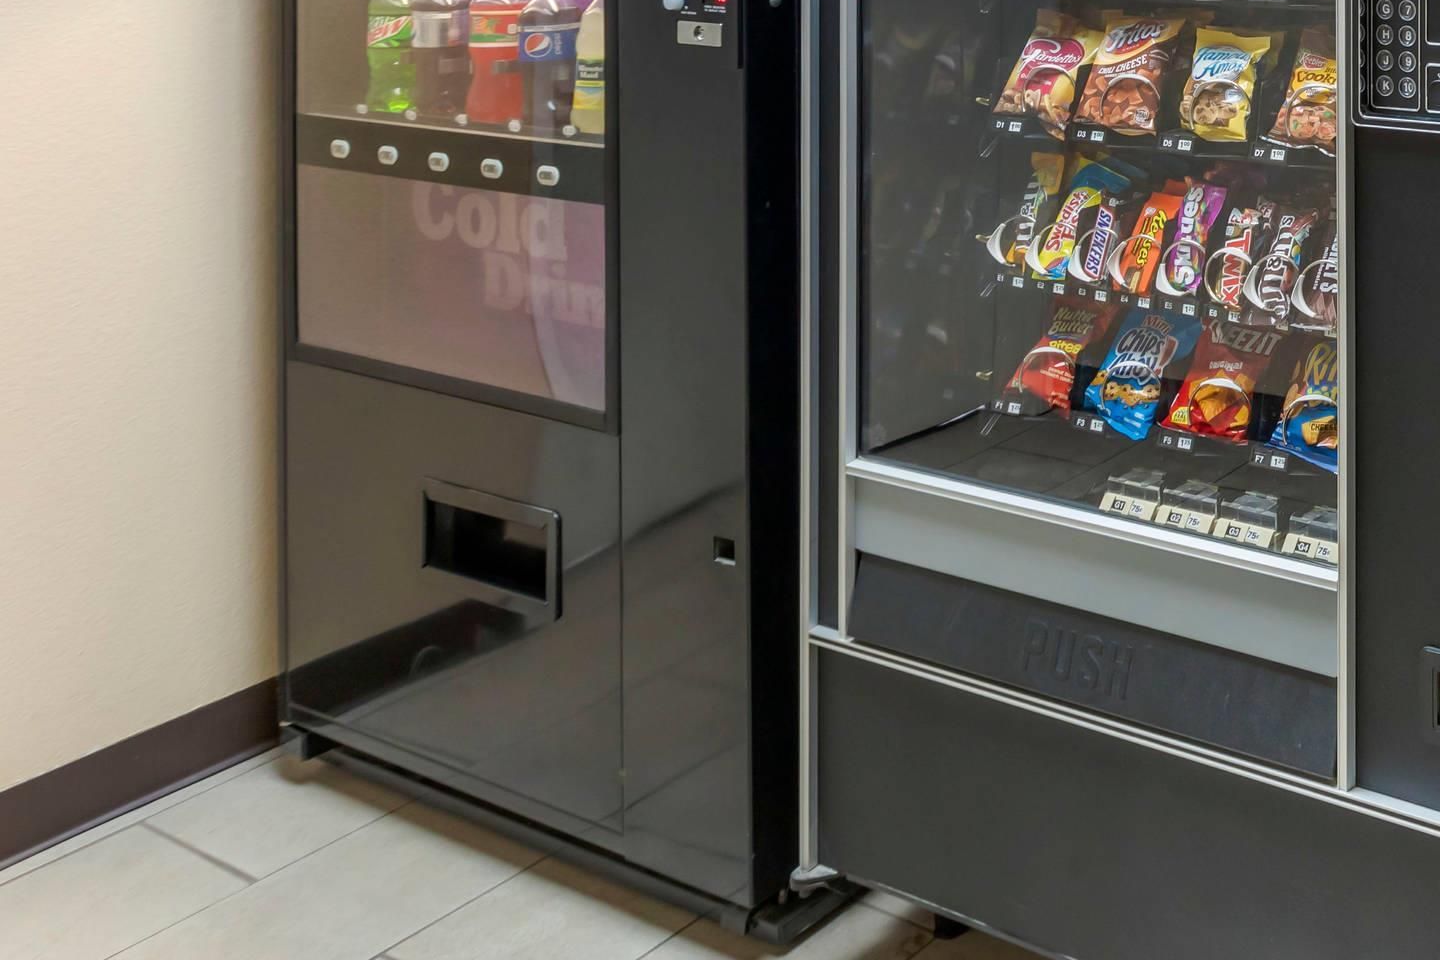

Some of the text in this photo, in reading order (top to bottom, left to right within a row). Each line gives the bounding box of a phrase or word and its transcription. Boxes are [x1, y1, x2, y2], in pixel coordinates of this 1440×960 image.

[1382, 4, 1412, 15] G 7
[1104, 22, 1165, 53] Fritos
[1382, 29, 1412, 41] H 8
[1097, 67, 1116, 75] CHILI
[1115, 53, 1149, 73] CHEESE
[1383, 55, 1412, 67] J 9
[1382, 81, 1414, 93] K 10
[996, 121, 1005, 129] D1
[1077, 130, 1087, 138] D3
[1163, 139, 1173, 147] D5
[1254, 149, 1265, 158] D7
[412, 183, 569, 261] Cold
[1086, 209, 1113, 276] SNICKERS
[1220, 227, 1252, 307] TWIX
[1052, 307, 1097, 321] Nutter
[1047, 320, 1094, 336] Butter
[1048, 340, 1083, 354] Bites
[1116, 327, 1166, 357] Chips
[995, 401, 1004, 409] F1
[1076, 418, 1086, 427] F3
[1163, 436, 1172, 444] F5
[1255, 455, 1265, 464] F7
[1114, 500, 1125, 510] G1
[1169, 512, 1181, 523] G2
[1228, 526, 1241, 537] G3
[1297, 542, 1310, 552] G4
[1023, 617, 1135, 700] PUSH
